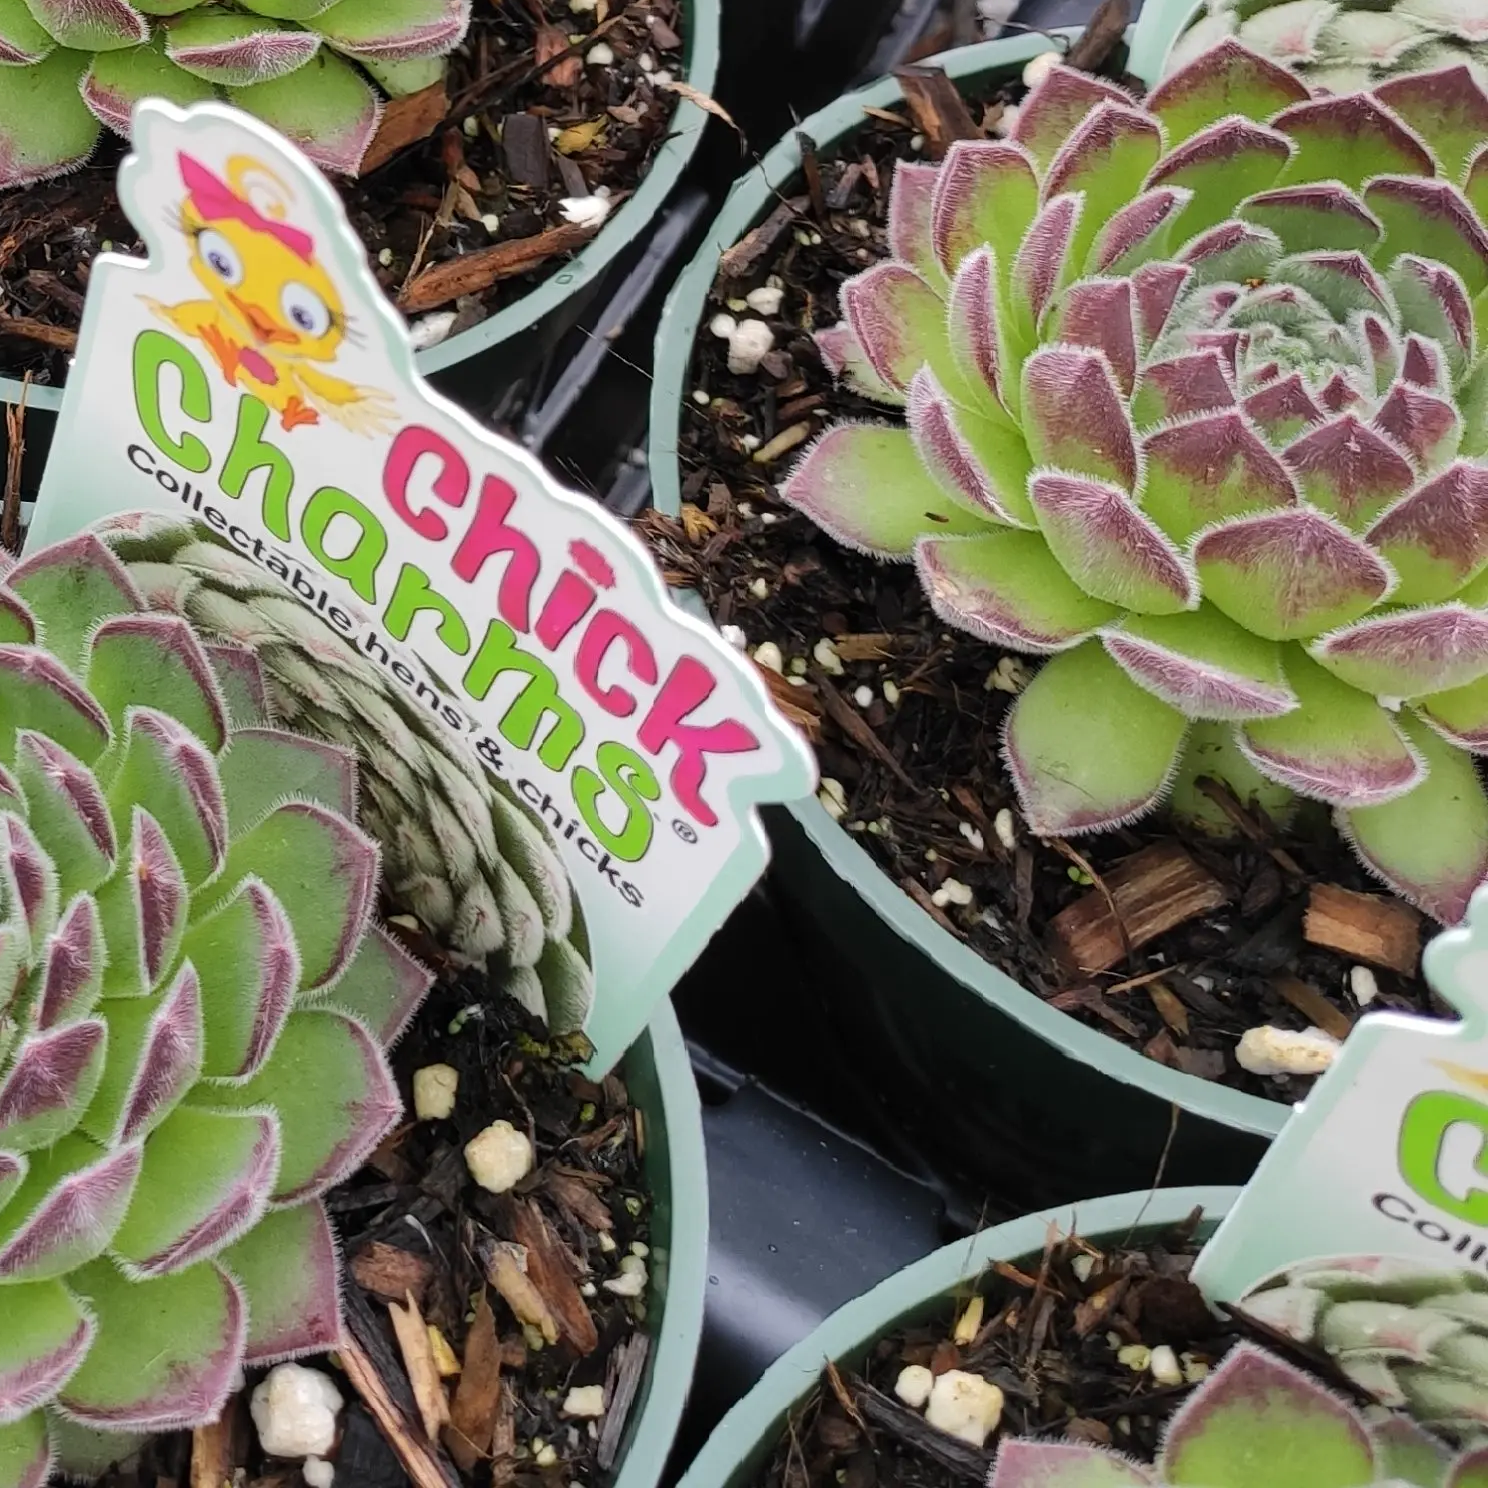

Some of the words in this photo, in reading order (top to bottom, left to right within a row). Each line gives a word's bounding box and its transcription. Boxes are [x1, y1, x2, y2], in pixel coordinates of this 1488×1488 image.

[126, 442, 352, 633] Collectable
[363, 634, 463, 733] hens
[474, 735, 506, 774] &
[515, 775, 648, 910] chicks
[131, 328, 663, 864] Charms
[382, 424, 762, 830] Chick
[1371, 1192, 1488, 1273] Coll
